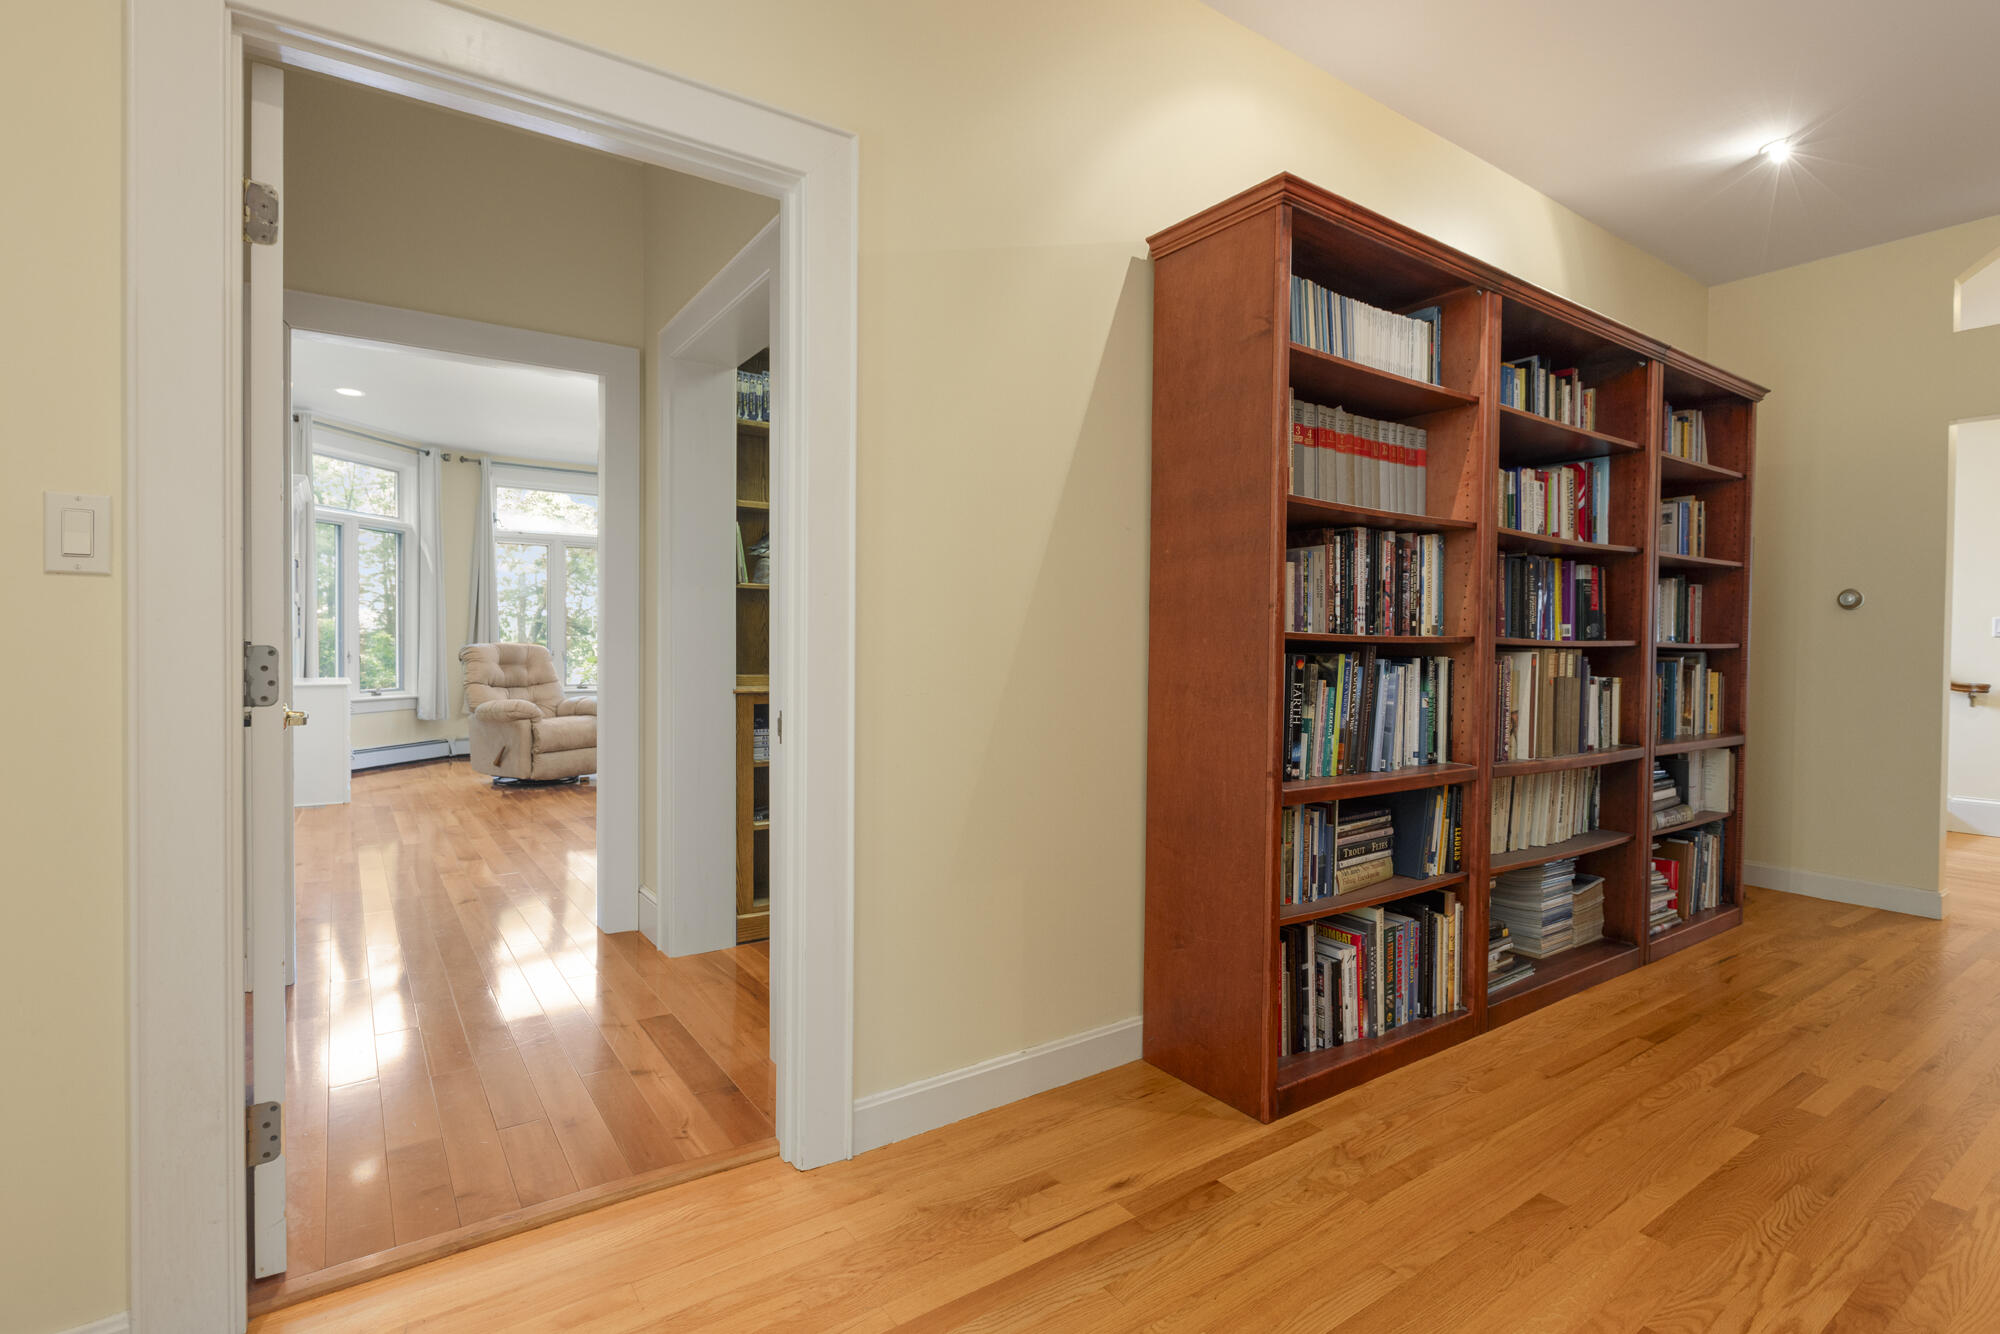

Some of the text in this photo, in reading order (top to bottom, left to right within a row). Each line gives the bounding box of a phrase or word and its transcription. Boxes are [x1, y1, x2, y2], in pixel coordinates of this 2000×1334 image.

[1295, 425, 1301, 435] 3
[1293, 682, 1302, 724] EARTH
[1343, 840, 1388, 858] TROUT FLIES
[1315, 924, 1353, 945] COMBAT
